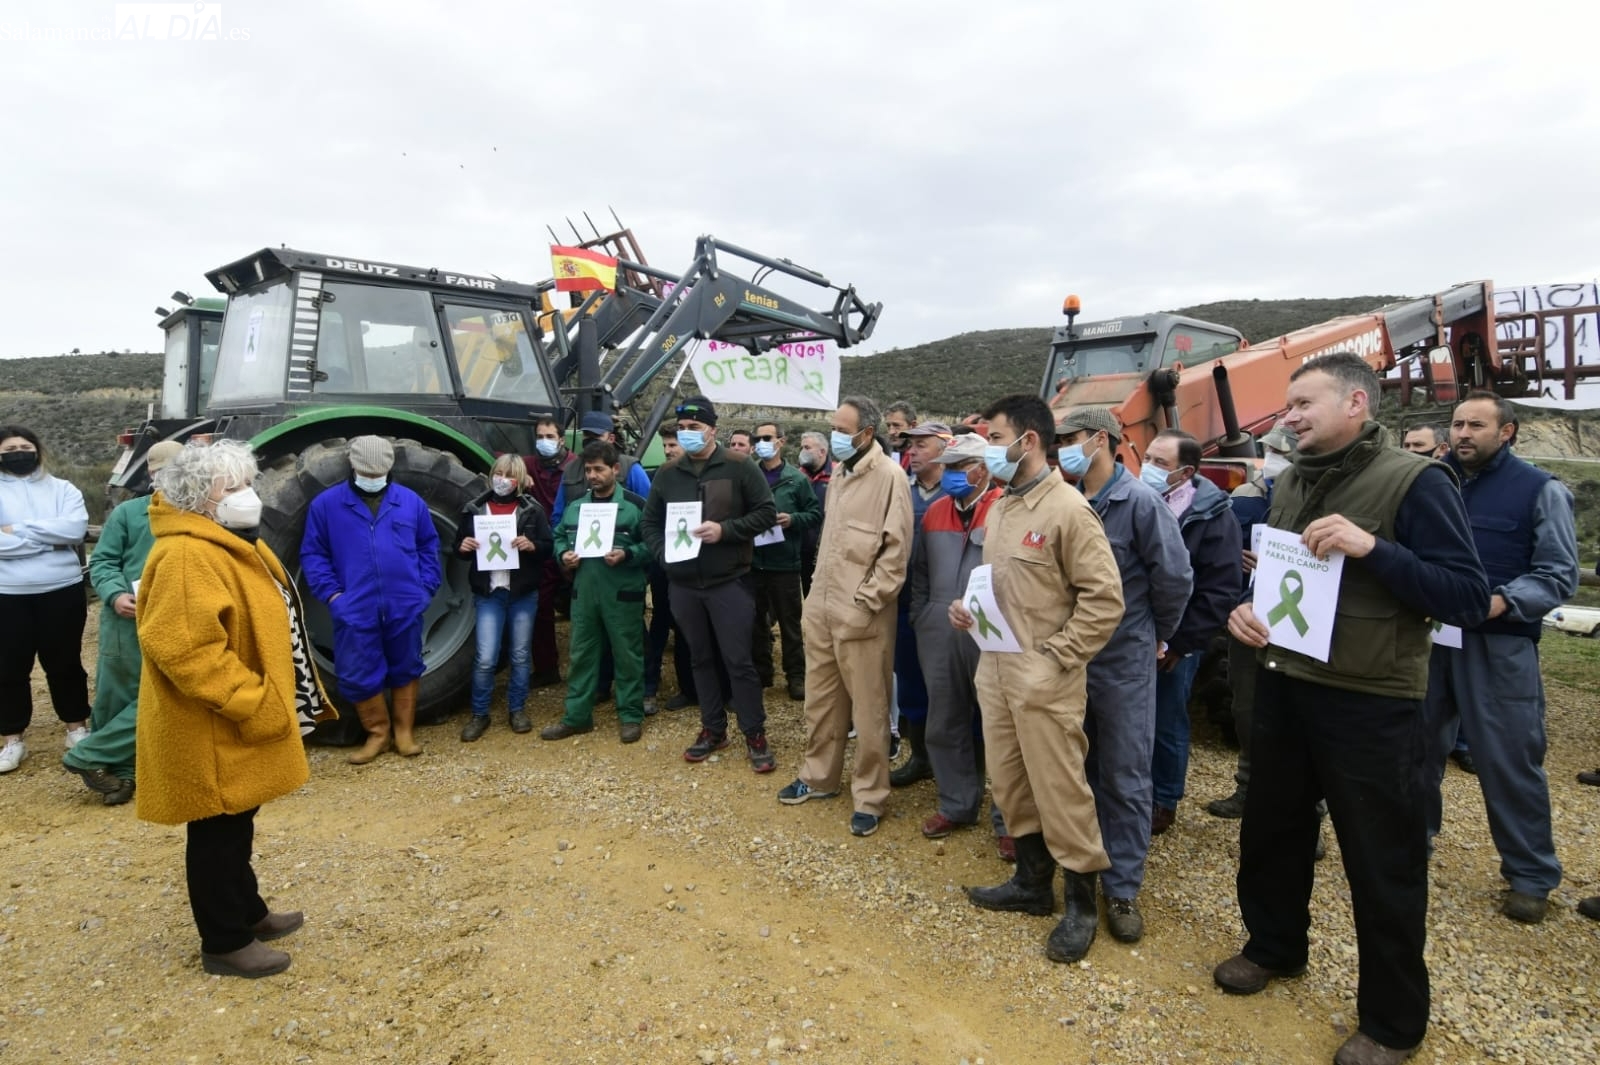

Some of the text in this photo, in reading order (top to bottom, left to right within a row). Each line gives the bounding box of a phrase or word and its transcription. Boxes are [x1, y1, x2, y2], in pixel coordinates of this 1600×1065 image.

[326, 258, 400, 277] DEUTZ
[445, 275, 497, 290] FAHR
[744, 289, 780, 309] tenias
[662, 334, 676, 352] 300
[1267, 540, 1299, 556] PRECIOS
[1265, 549, 1329, 573] PARA EL CAMPO
